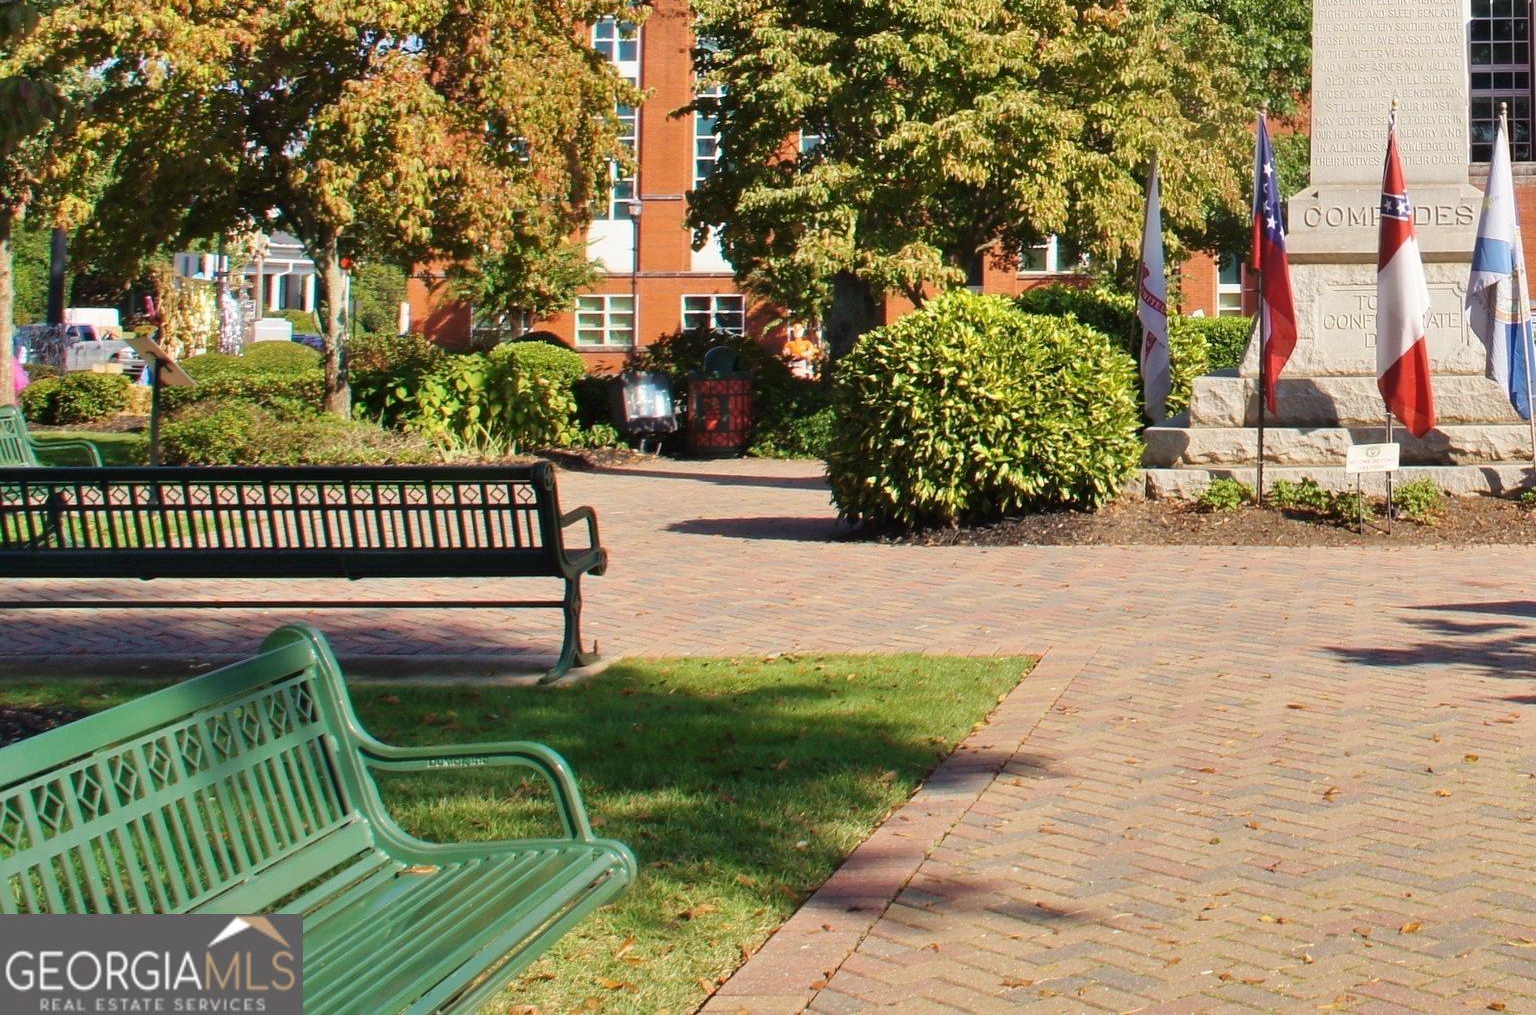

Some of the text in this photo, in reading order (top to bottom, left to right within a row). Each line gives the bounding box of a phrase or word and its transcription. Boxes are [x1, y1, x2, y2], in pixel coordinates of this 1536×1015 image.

[1318, 8, 1460, 20] FIGHTING AND SLEEP BENEATH
[1314, 22, 1332, 32] THE
[1333, 22, 1351, 32] SOD
[1353, 22, 1366, 32] OF
[1367, 22, 1395, 32] EVERY
[1395, 21, 1436, 32] SOUTHERN
[1315, 34, 1461, 46] THOSE WHO HAVE PASSED AWAY
[1315, 49, 1325, 59] IN
[1328, 49, 1348, 59] THE
[1351, 49, 1384, 59] AFTER
[1385, 49, 1417, 59] YEARS
[1418, 49, 1430, 58] OF
[1317, 62, 1461, 73] AND WHOSE ASHES NOW HALLOW
[1325, 75, 1346, 86] OLD
[1350, 74, 1394, 85] HENRY'S
[1396, 74, 1421, 85] HILL
[1316, 89, 1346, 99] THOSE
[1348, 89, 1367, 99] WHO
[1369, 89, 1390, 99] LIKE
[1392, 88, 1401, 99] A
[1327, 102, 1359, 113] STILL
[1401, 101, 1421, 112] OUR
[1315, 116, 1335, 126] MAY
[1339, 115, 1357, 126] GOD
[1409, 114, 1453, 125] FOREVER
[1454, 114, 1464, 124] IN
[1315, 129, 1332, 140] OUR
[1400, 128, 1438, 139] MEMORY
[1441, 128, 1464, 138] AND
[1318, 143, 1328, 153] IN
[1330, 143, 1349, 153] ALL
[1397, 142, 1445, 152] NOWLEDGE
[1448, 141, 1461, 152] OF
[1315, 157, 1341, 167] THEIR
[1343, 157, 1382, 167] MOTIVES
[1404, 156, 1431, 166] THEIR
